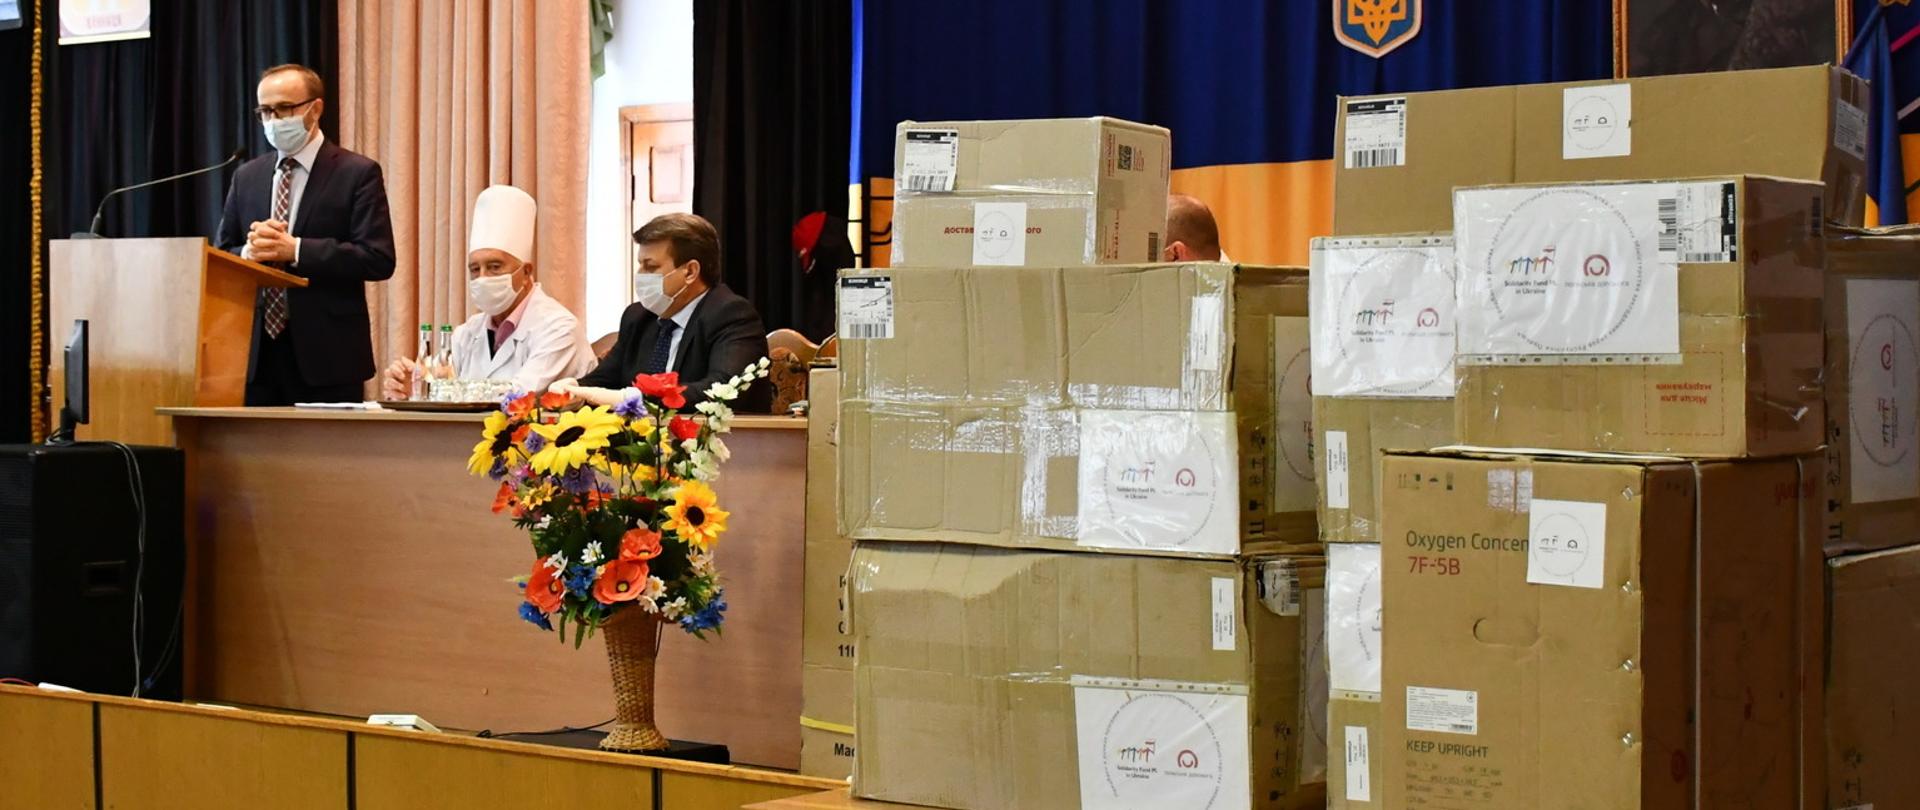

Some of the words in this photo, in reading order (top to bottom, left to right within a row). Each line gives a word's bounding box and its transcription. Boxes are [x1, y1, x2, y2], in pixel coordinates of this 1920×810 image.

[1504, 279, 1532, 288] Solidarity
[1533, 279, 1548, 287] Fund
[1406, 530, 1466, 553] Oxygen
[1471, 533, 1529, 552] Concen
[1408, 556, 1461, 576] 7F-5B
[1406, 739, 1435, 753] KEEP
[1438, 742, 1489, 759] UPRIGHT
[1117, 765, 1139, 773] Solidarity
[1139, 766, 1151, 774] Fund
